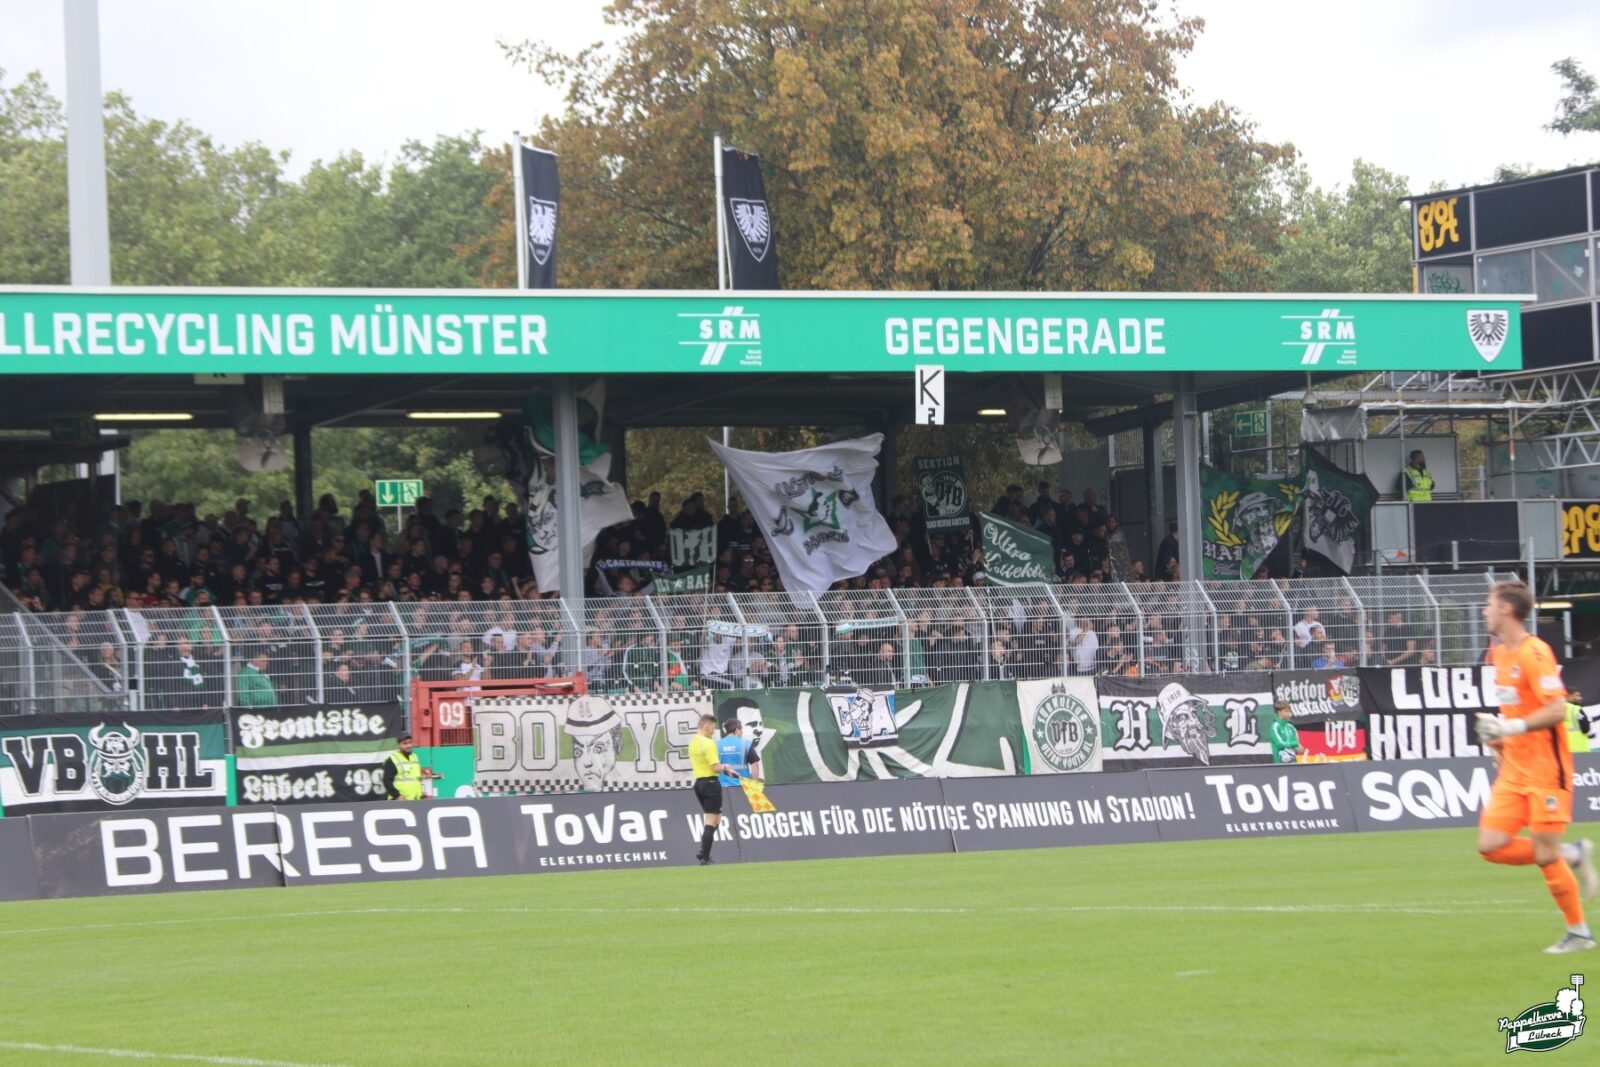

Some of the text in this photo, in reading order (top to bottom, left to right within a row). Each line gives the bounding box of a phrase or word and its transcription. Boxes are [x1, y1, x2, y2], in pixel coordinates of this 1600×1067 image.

[330, 304, 549, 356] MÜNSTER
[884, 317, 1167, 355] GEGENGERADE
[920, 369, 941, 406] K
[918, 455, 960, 469] SEKTION
[439, 701, 465, 727] 09
[243, 771, 335, 802] Lübeck
[1362, 767, 1492, 822] SQM
[737, 810, 816, 839] SORGEN
[820, 805, 859, 835] FÜR
[863, 806, 896, 833] DIE
[900, 801, 970, 832] NÖTIGE
[972, 799, 1074, 831] SPANNUNG
[1079, 798, 1103, 825] IM
[1105, 791, 1197, 823] STADION!
[1225, 818, 1340, 833] ELEKTROTECHNIK
[101, 806, 489, 887] BERESA
[540, 851, 667, 867] ELEKTROTECHNIK
